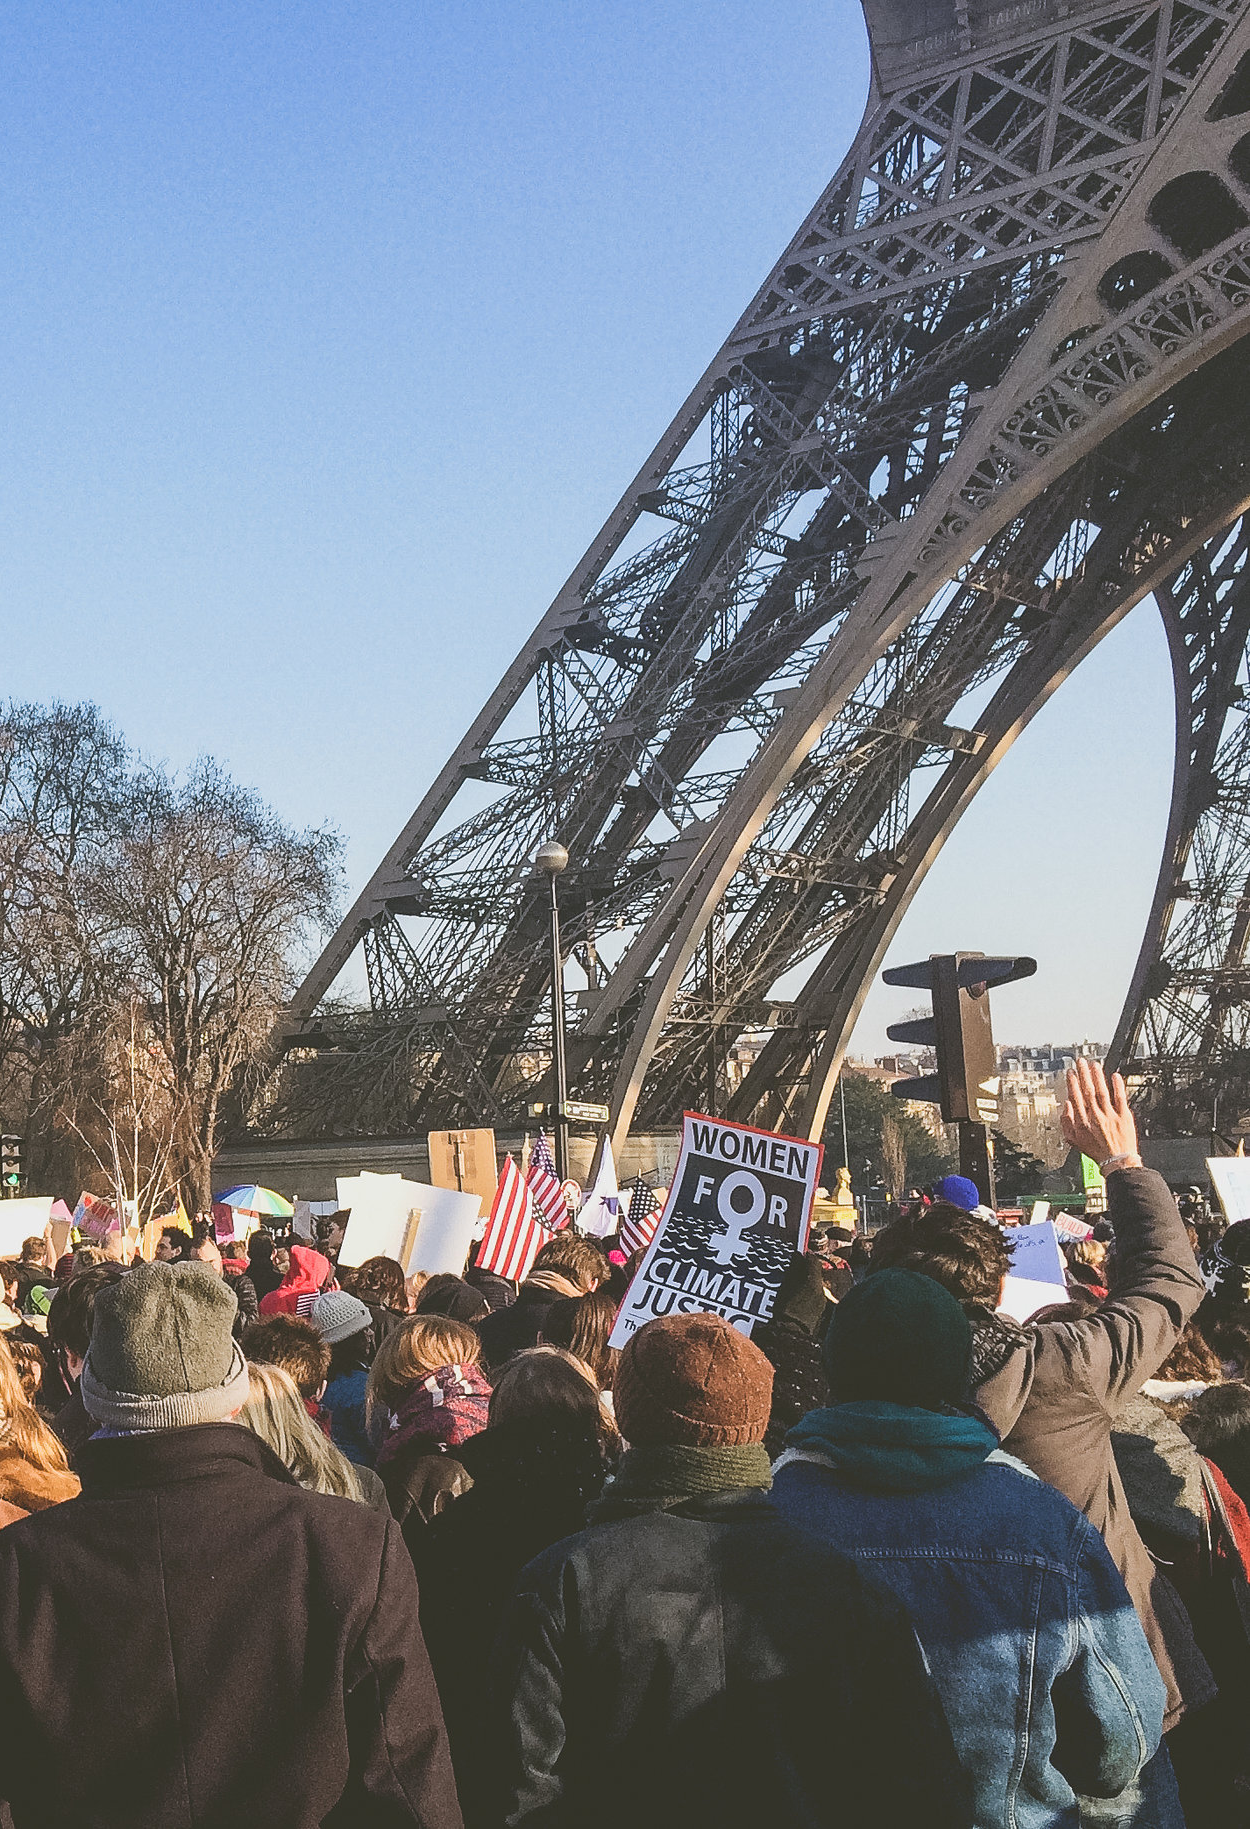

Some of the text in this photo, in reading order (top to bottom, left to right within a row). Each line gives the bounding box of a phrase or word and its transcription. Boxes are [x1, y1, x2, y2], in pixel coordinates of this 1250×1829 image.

[692, 1122, 810, 1179] WOMEN
[693, 1170, 789, 1229] FOR
[632, 1284, 752, 1327] JUST
[650, 1257, 778, 1318] CLIMATE
